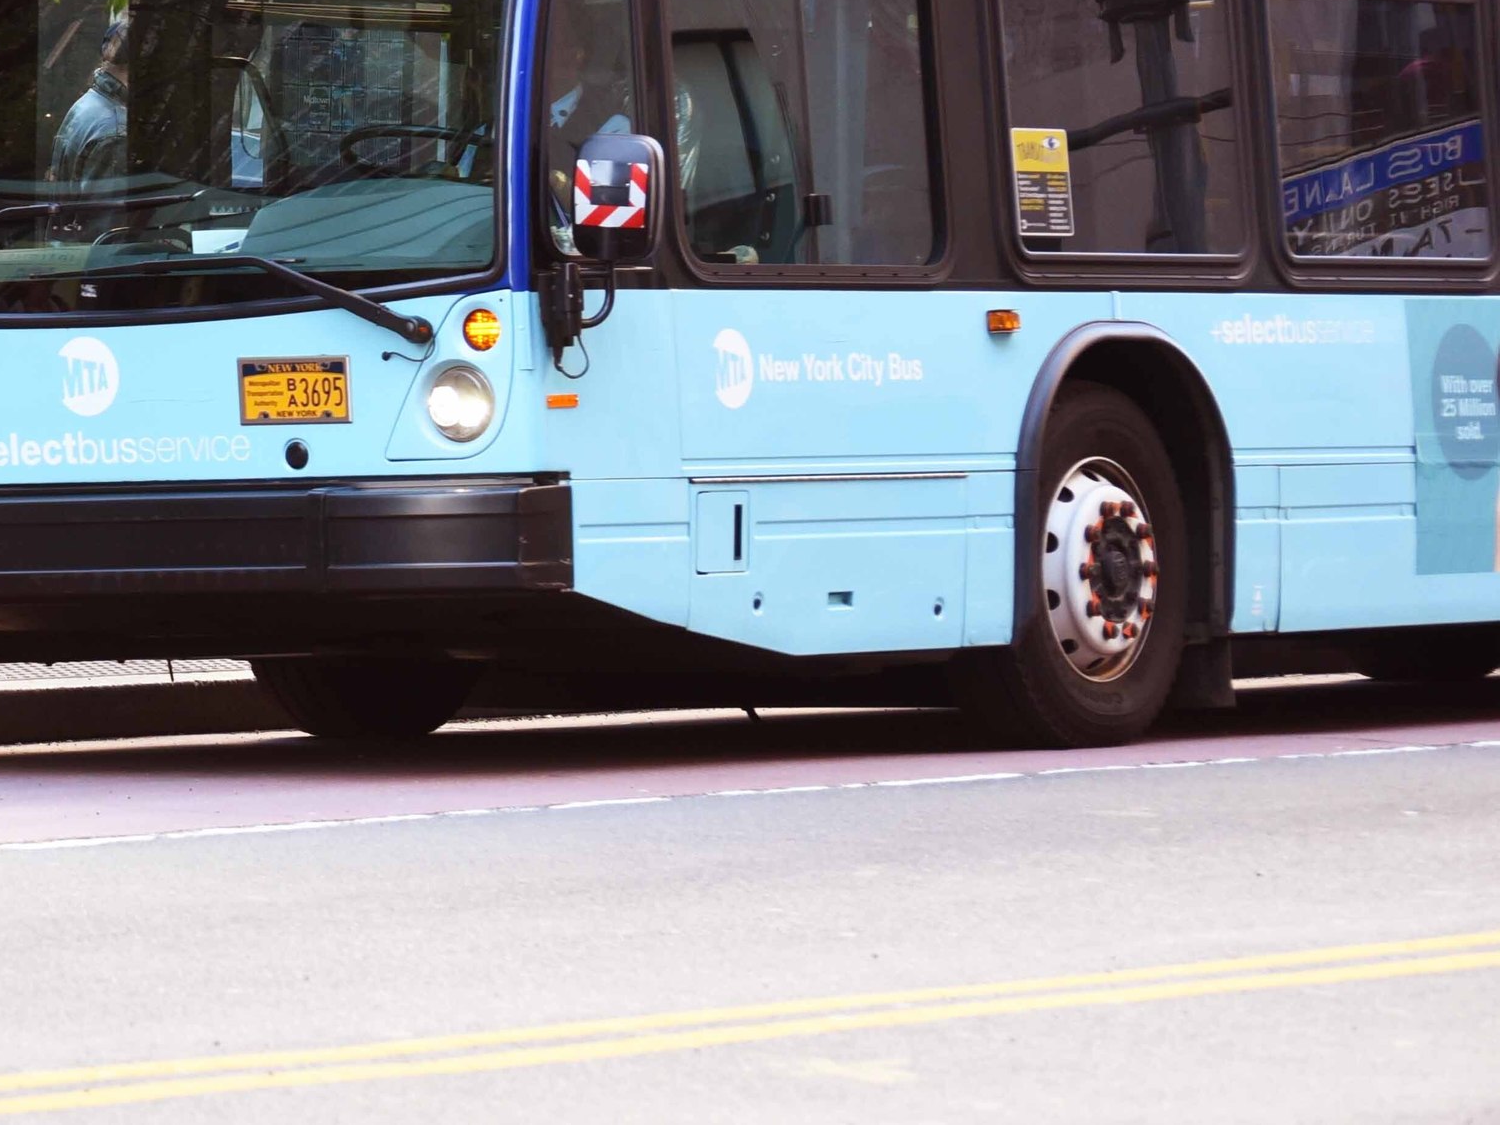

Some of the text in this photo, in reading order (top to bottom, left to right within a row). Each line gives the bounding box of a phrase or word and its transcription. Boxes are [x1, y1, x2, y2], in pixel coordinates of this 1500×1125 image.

[267, 362, 322, 373] NEW YORK
[759, 351, 923, 387] New York City Bus
[1441, 374, 1494, 393] With over
[276, 410, 294, 418] NEW
[1440, 398, 1496, 417] 25 Million
